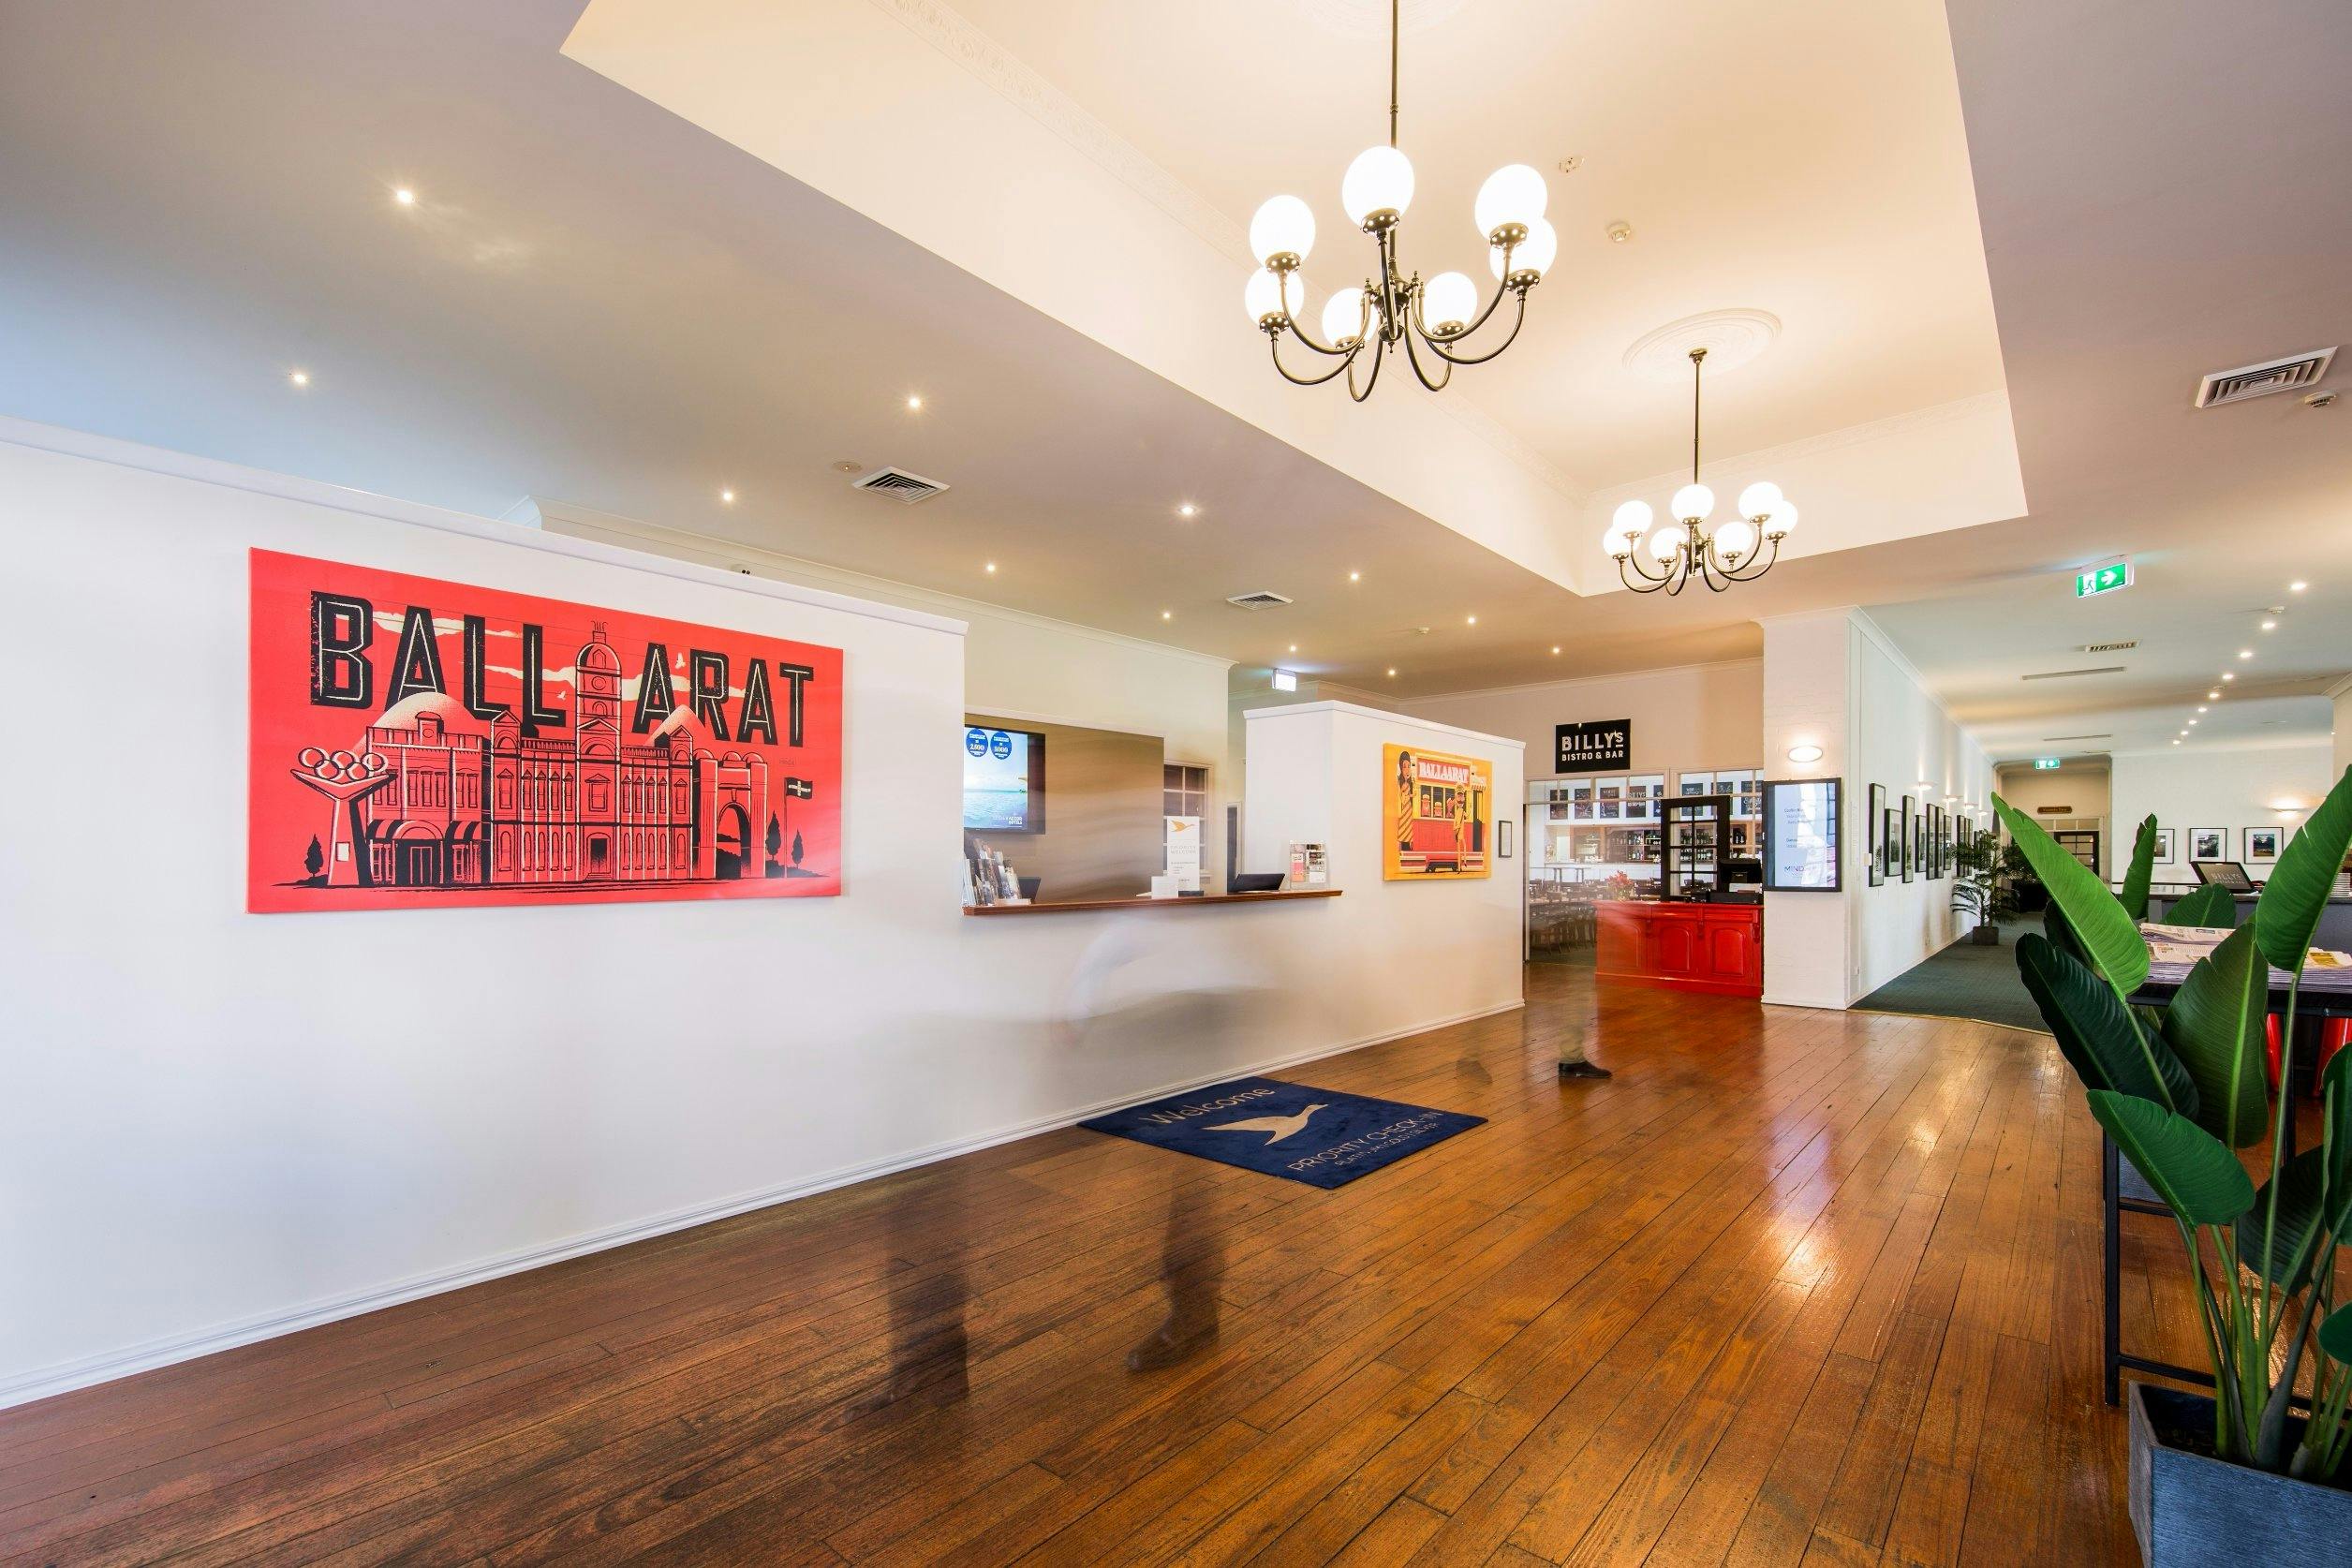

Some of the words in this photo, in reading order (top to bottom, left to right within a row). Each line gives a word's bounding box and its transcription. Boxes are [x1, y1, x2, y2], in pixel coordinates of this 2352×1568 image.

[1561, 752, 1593, 762] BISTRO
[1595, 751, 1603, 760] &
[1605, 749, 1624, 759] BAR
[1137, 1087, 1276, 1124] Welcome
[1287, 1138, 1370, 1172] PRIORITY
